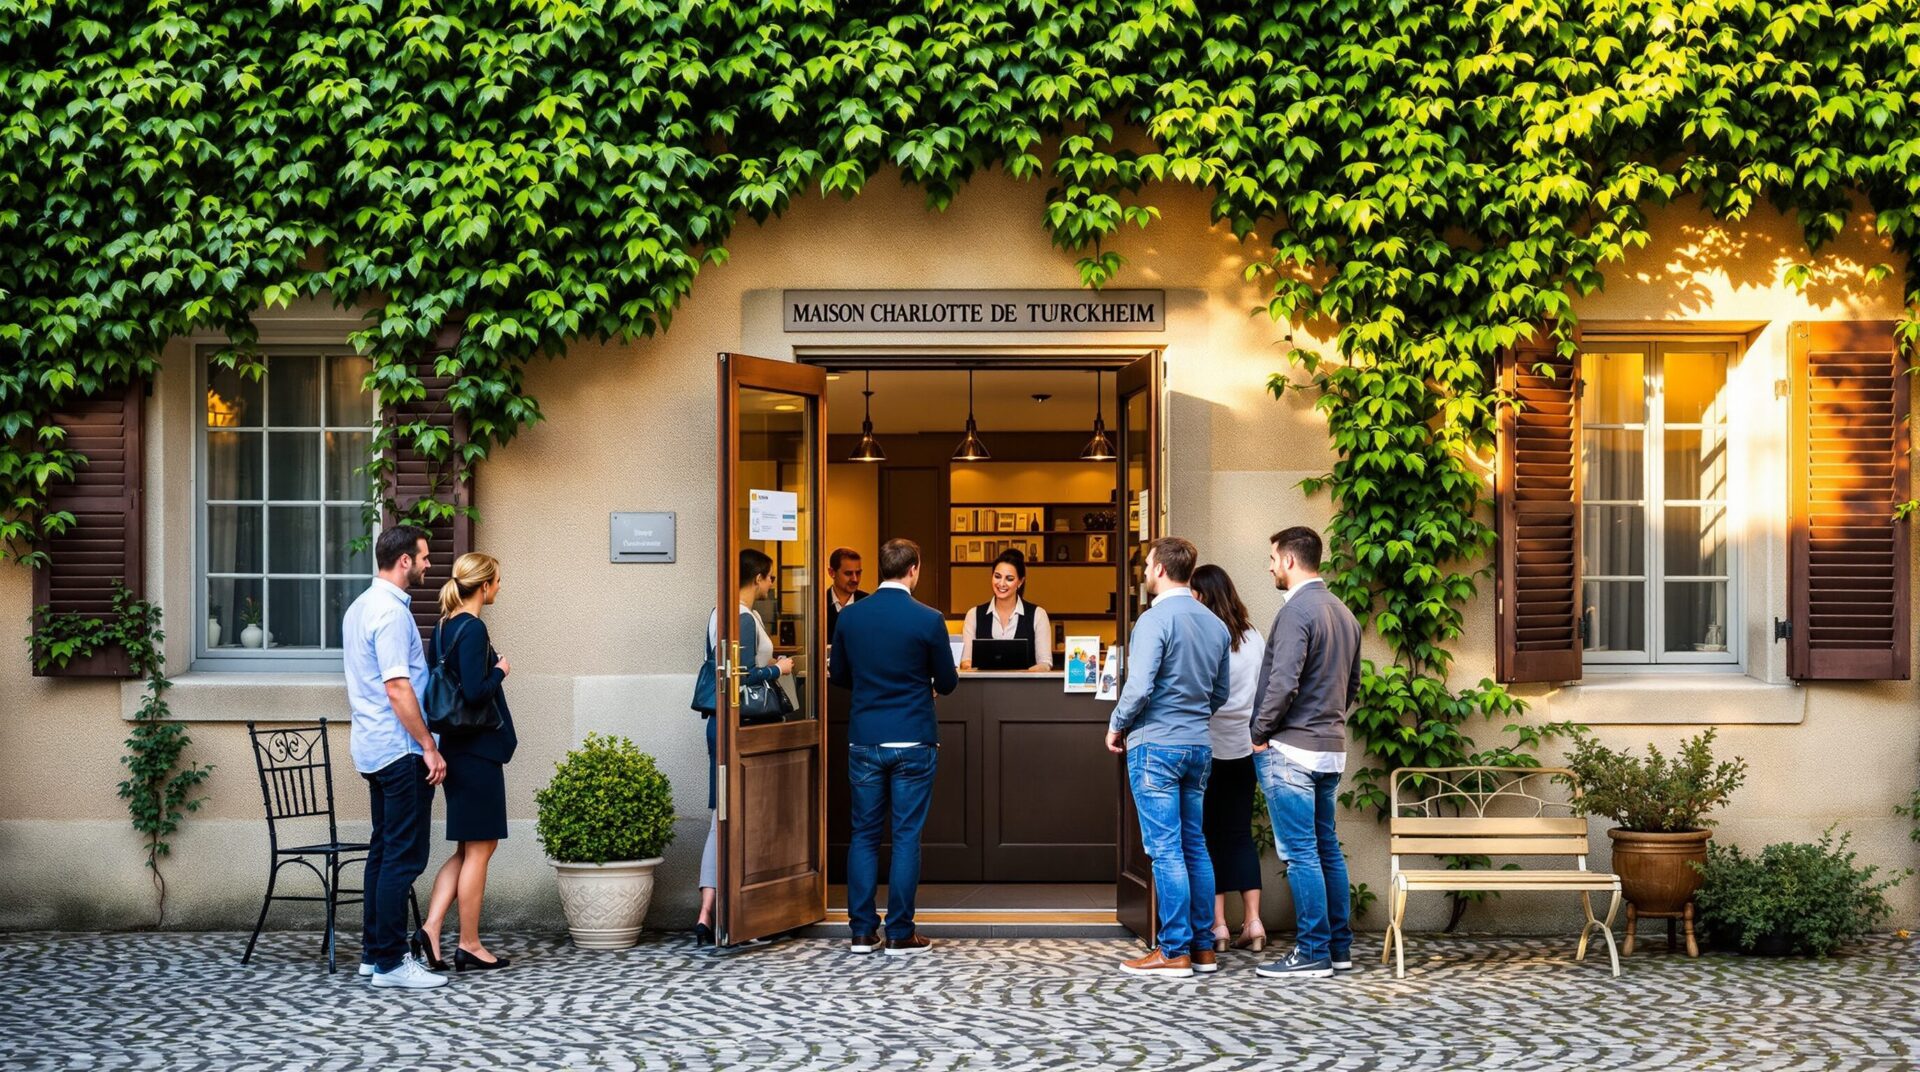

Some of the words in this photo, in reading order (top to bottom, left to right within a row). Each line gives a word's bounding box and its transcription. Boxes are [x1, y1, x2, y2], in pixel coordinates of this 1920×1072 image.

[793, 303, 865, 323] MAISON
[870, 303, 983, 323] CHARLOTTE
[991, 303, 1018, 323] DE
[1027, 303, 1155, 323] TURCKHEIM
